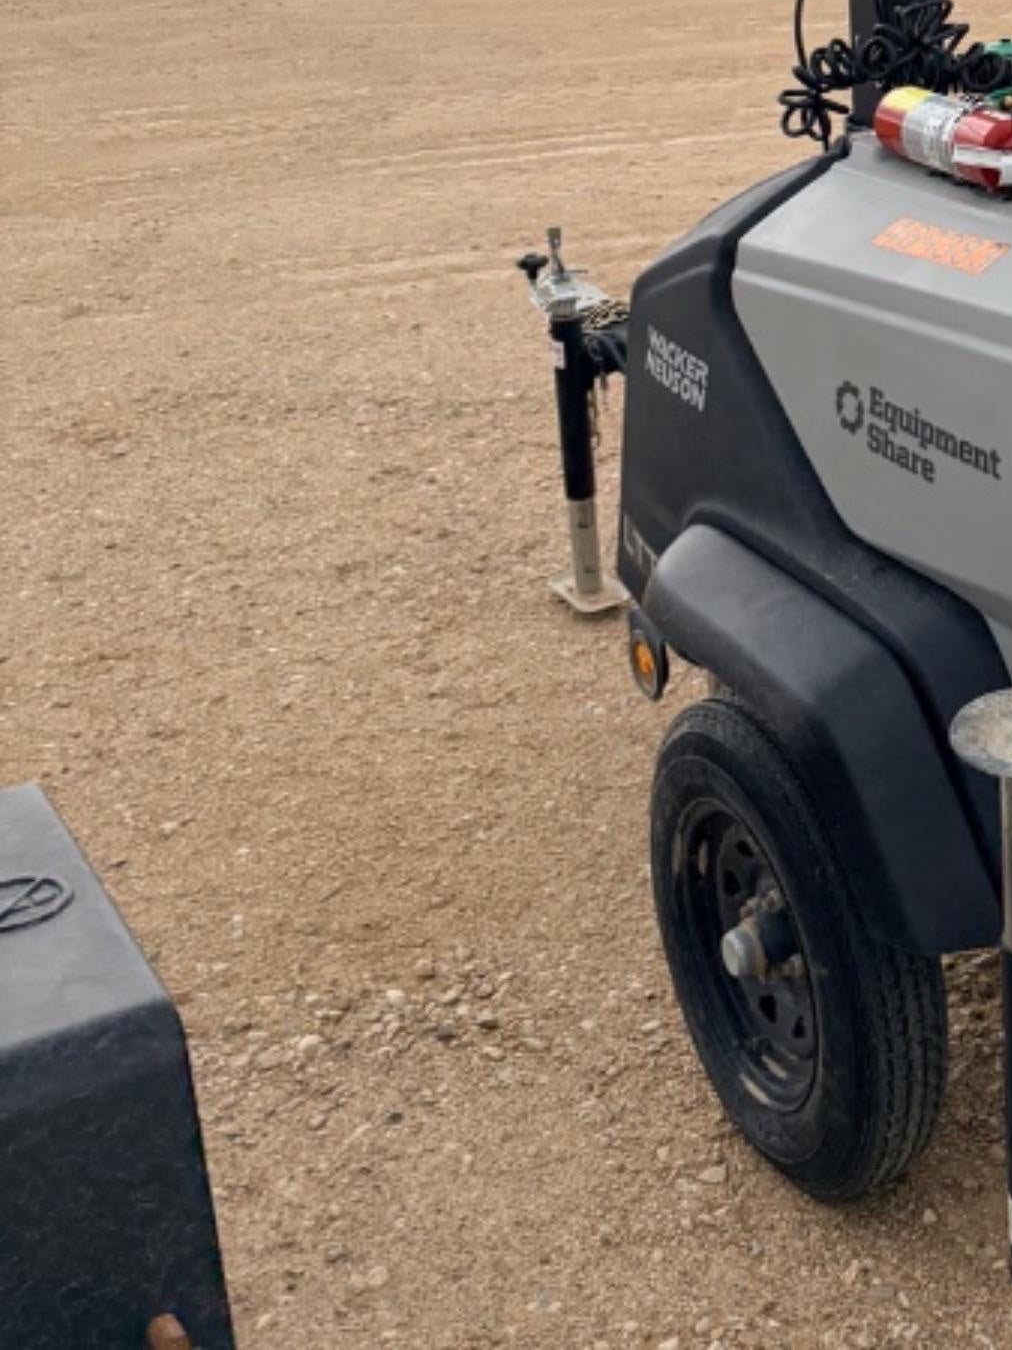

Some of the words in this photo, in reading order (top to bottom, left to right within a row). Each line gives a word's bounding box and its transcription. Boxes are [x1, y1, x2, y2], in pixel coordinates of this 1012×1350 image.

[645, 349, 706, 412] NEUSON
[647, 323, 709, 386] WACKER
[866, 427, 937, 484] Share
[869, 385, 1003, 480] Equipment
